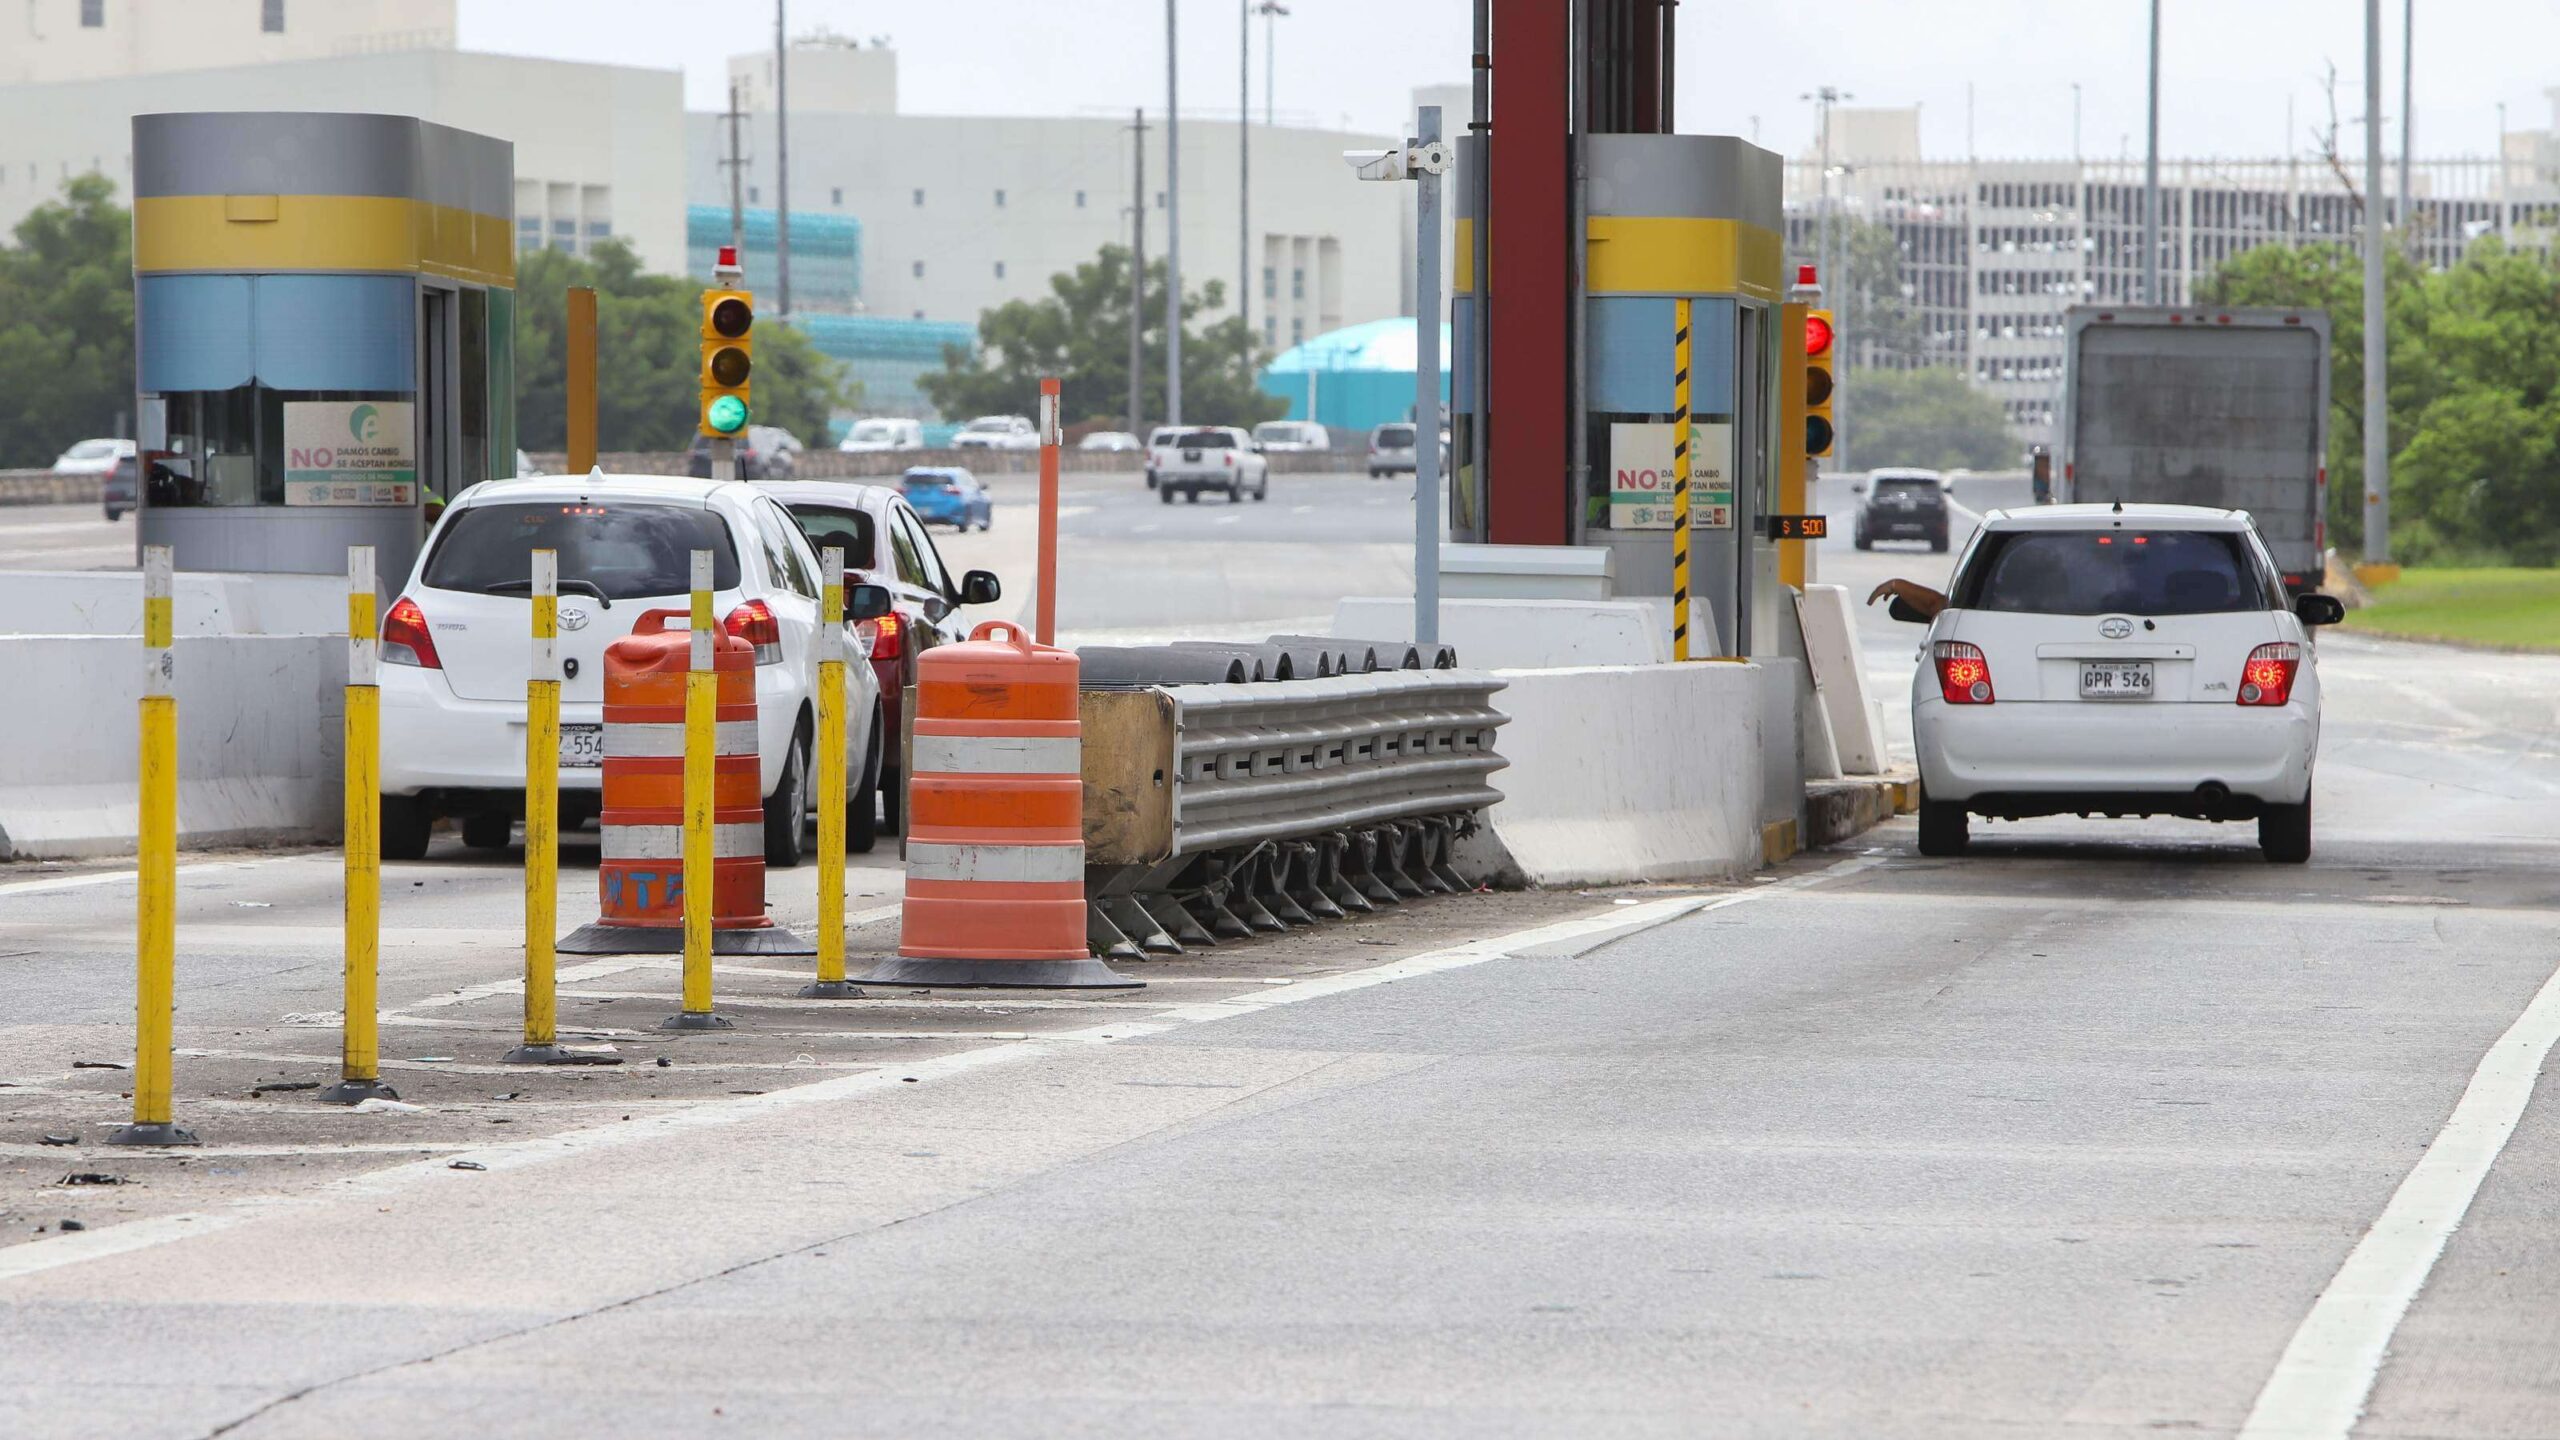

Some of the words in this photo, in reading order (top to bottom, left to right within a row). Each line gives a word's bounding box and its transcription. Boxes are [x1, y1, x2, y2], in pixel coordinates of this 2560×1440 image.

[290, 447, 333, 468] NO
[336, 447, 369, 456] DAMOS
[1617, 469, 1658, 489] NO
[1694, 469, 1720, 478] CAMBIO
[1698, 509, 1712, 518] VISA
[1782, 519, 1791, 535] $
[2085, 671, 2113, 688] GPR
[2122, 671, 2150, 688] 526
[574, 735, 602, 755] 554
